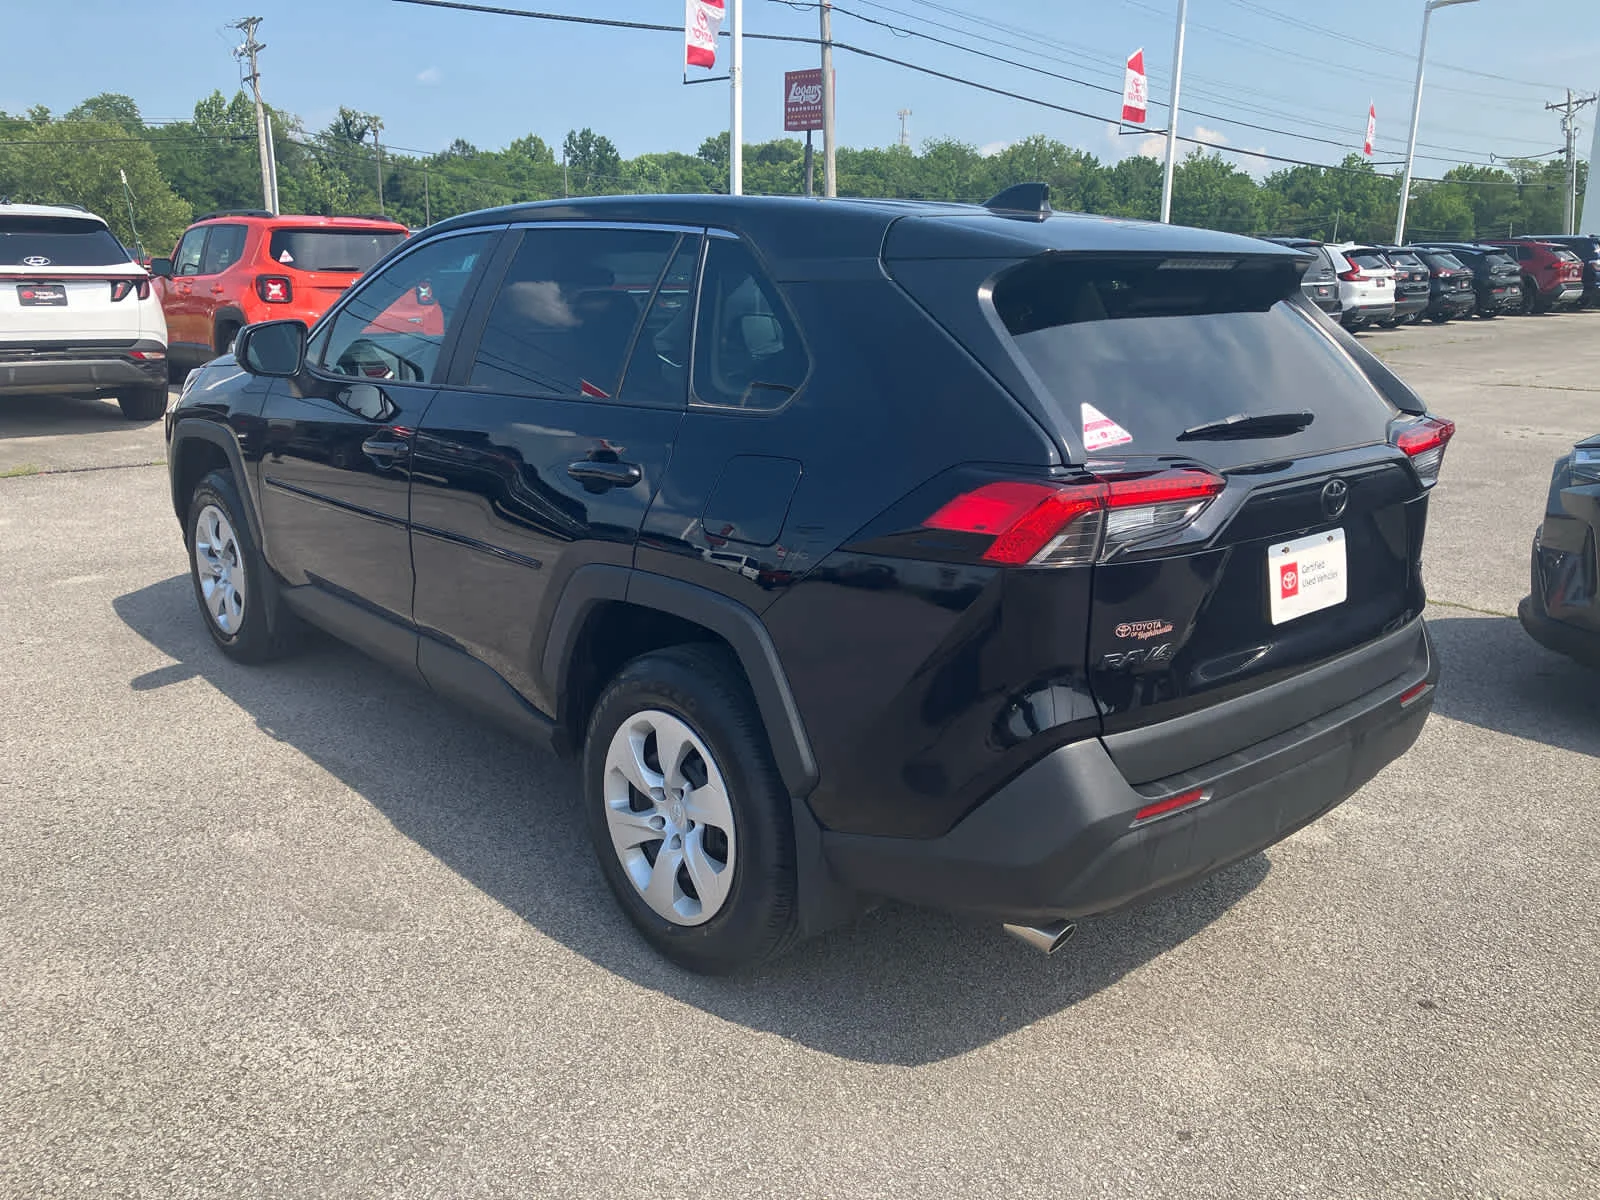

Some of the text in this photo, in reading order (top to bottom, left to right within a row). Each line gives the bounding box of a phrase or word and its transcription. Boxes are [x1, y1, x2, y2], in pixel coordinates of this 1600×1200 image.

[1302, 560, 1329, 574] Certified
[1302, 571, 1338, 588] Used Vehicles
[1132, 621, 1161, 631] TOYOTA
